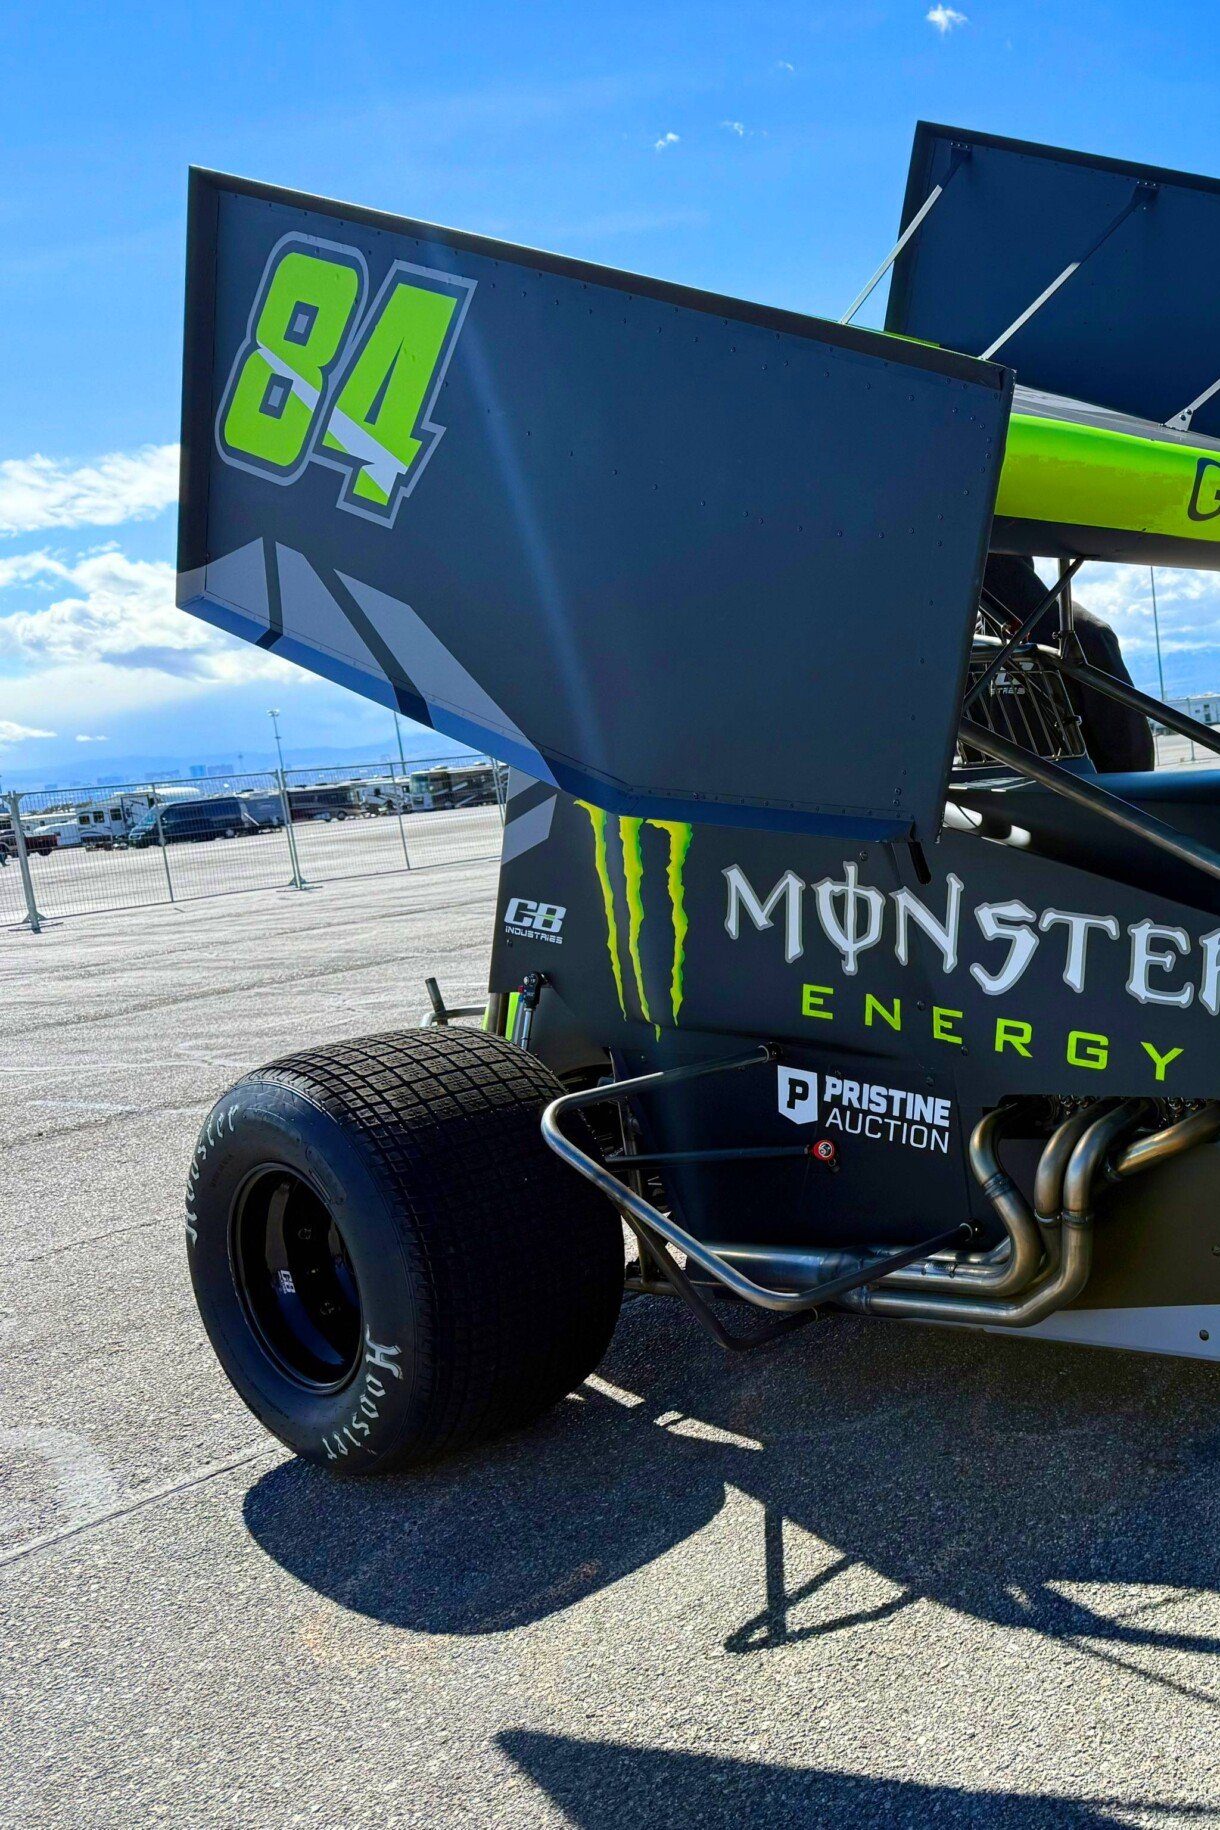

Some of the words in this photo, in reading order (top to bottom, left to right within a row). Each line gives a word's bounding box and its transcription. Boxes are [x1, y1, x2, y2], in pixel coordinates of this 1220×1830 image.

[214, 230, 478, 529] 84
[505, 925, 563, 945] INDUSTRIES
[801, 982, 1185, 1082] ENERGY
[823, 1074, 952, 1128] PRISTINE
[825, 1107, 950, 1155] AUCTION
[321, 1323, 404, 1460] Hoosier
